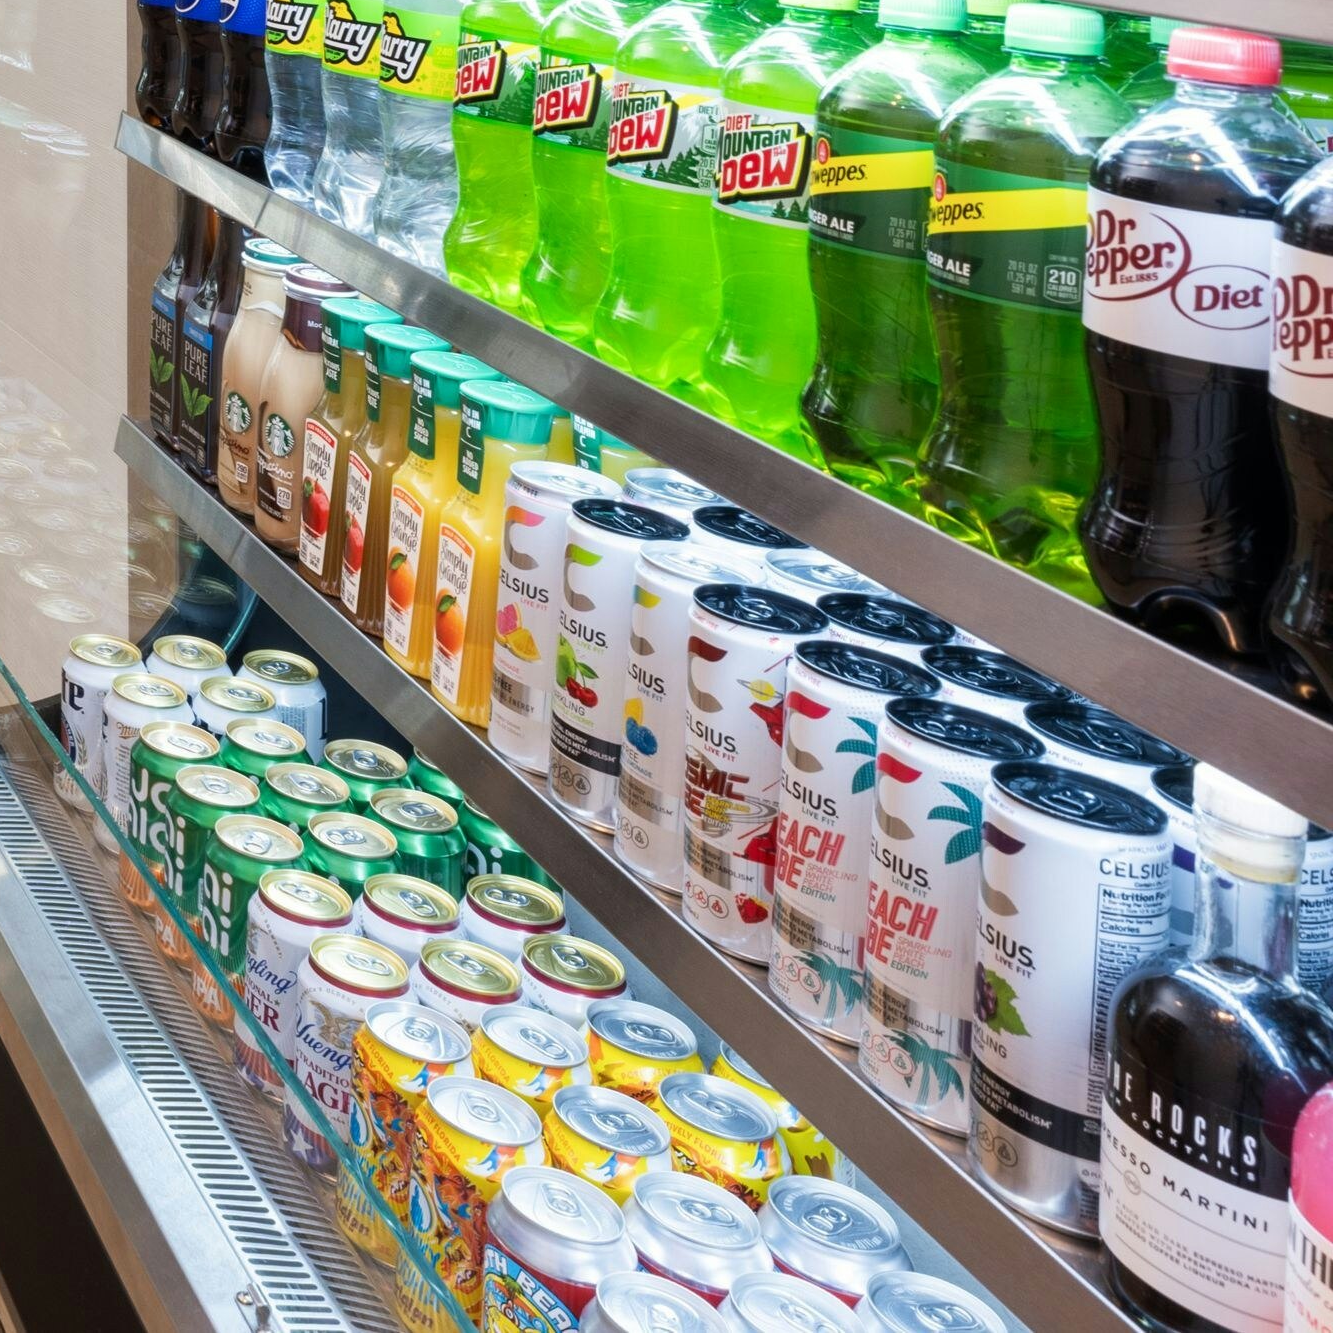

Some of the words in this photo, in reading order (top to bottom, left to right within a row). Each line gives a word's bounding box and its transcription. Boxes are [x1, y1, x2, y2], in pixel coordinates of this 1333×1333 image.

[829, 216, 855, 235] ALE
[1096, 208, 1137, 248] Dr
[946, 257, 971, 277] ALE
[1048, 268, 1076, 285] 210
[1086, 241, 1177, 288] epper
[1046, 283, 1079, 294] CALORIES
[1193, 283, 1264, 312] Diet
[150, 308, 174, 336] PURE
[150, 324, 173, 353] LEAF
[184, 339, 209, 367] PURE
[183, 355, 208, 385] LEAF
[462, 455, 479, 471] ADDED
[462, 463, 479, 480] SUGAR
[277, 488, 290, 501] 270
[500, 568, 549, 604] ELSIUS
[778, 811, 846, 867] EACH
[803, 877, 833, 894] PEACH
[805, 869, 835, 887] WHITE
[806, 862, 859, 883] SPARKLING
[800, 884, 837, 903] EDITION
[1102, 887, 1154, 903] Nutrition
[867, 881, 939, 941] EACH
[797, 925, 851, 955] METABOLISM
[1100, 921, 1140, 934] Calories
[893, 951, 925, 970] PEACH
[895, 943, 927, 962] WHITE
[896, 935, 952, 958] SPARKLING
[890, 959, 929, 979] EDITION
[296, 1015, 352, 1069] Yueng
[991, 1087, 1053, 1130] METABOLISM
[432, 1122, 461, 1162] FLORIDA
[1150, 1088, 1259, 1169] ROCKS
[1131, 1110, 1257, 1182] COCKTAILS
[1161, 1174, 1269, 1233] MARTINI
[515, 1267, 574, 1330] BEA
